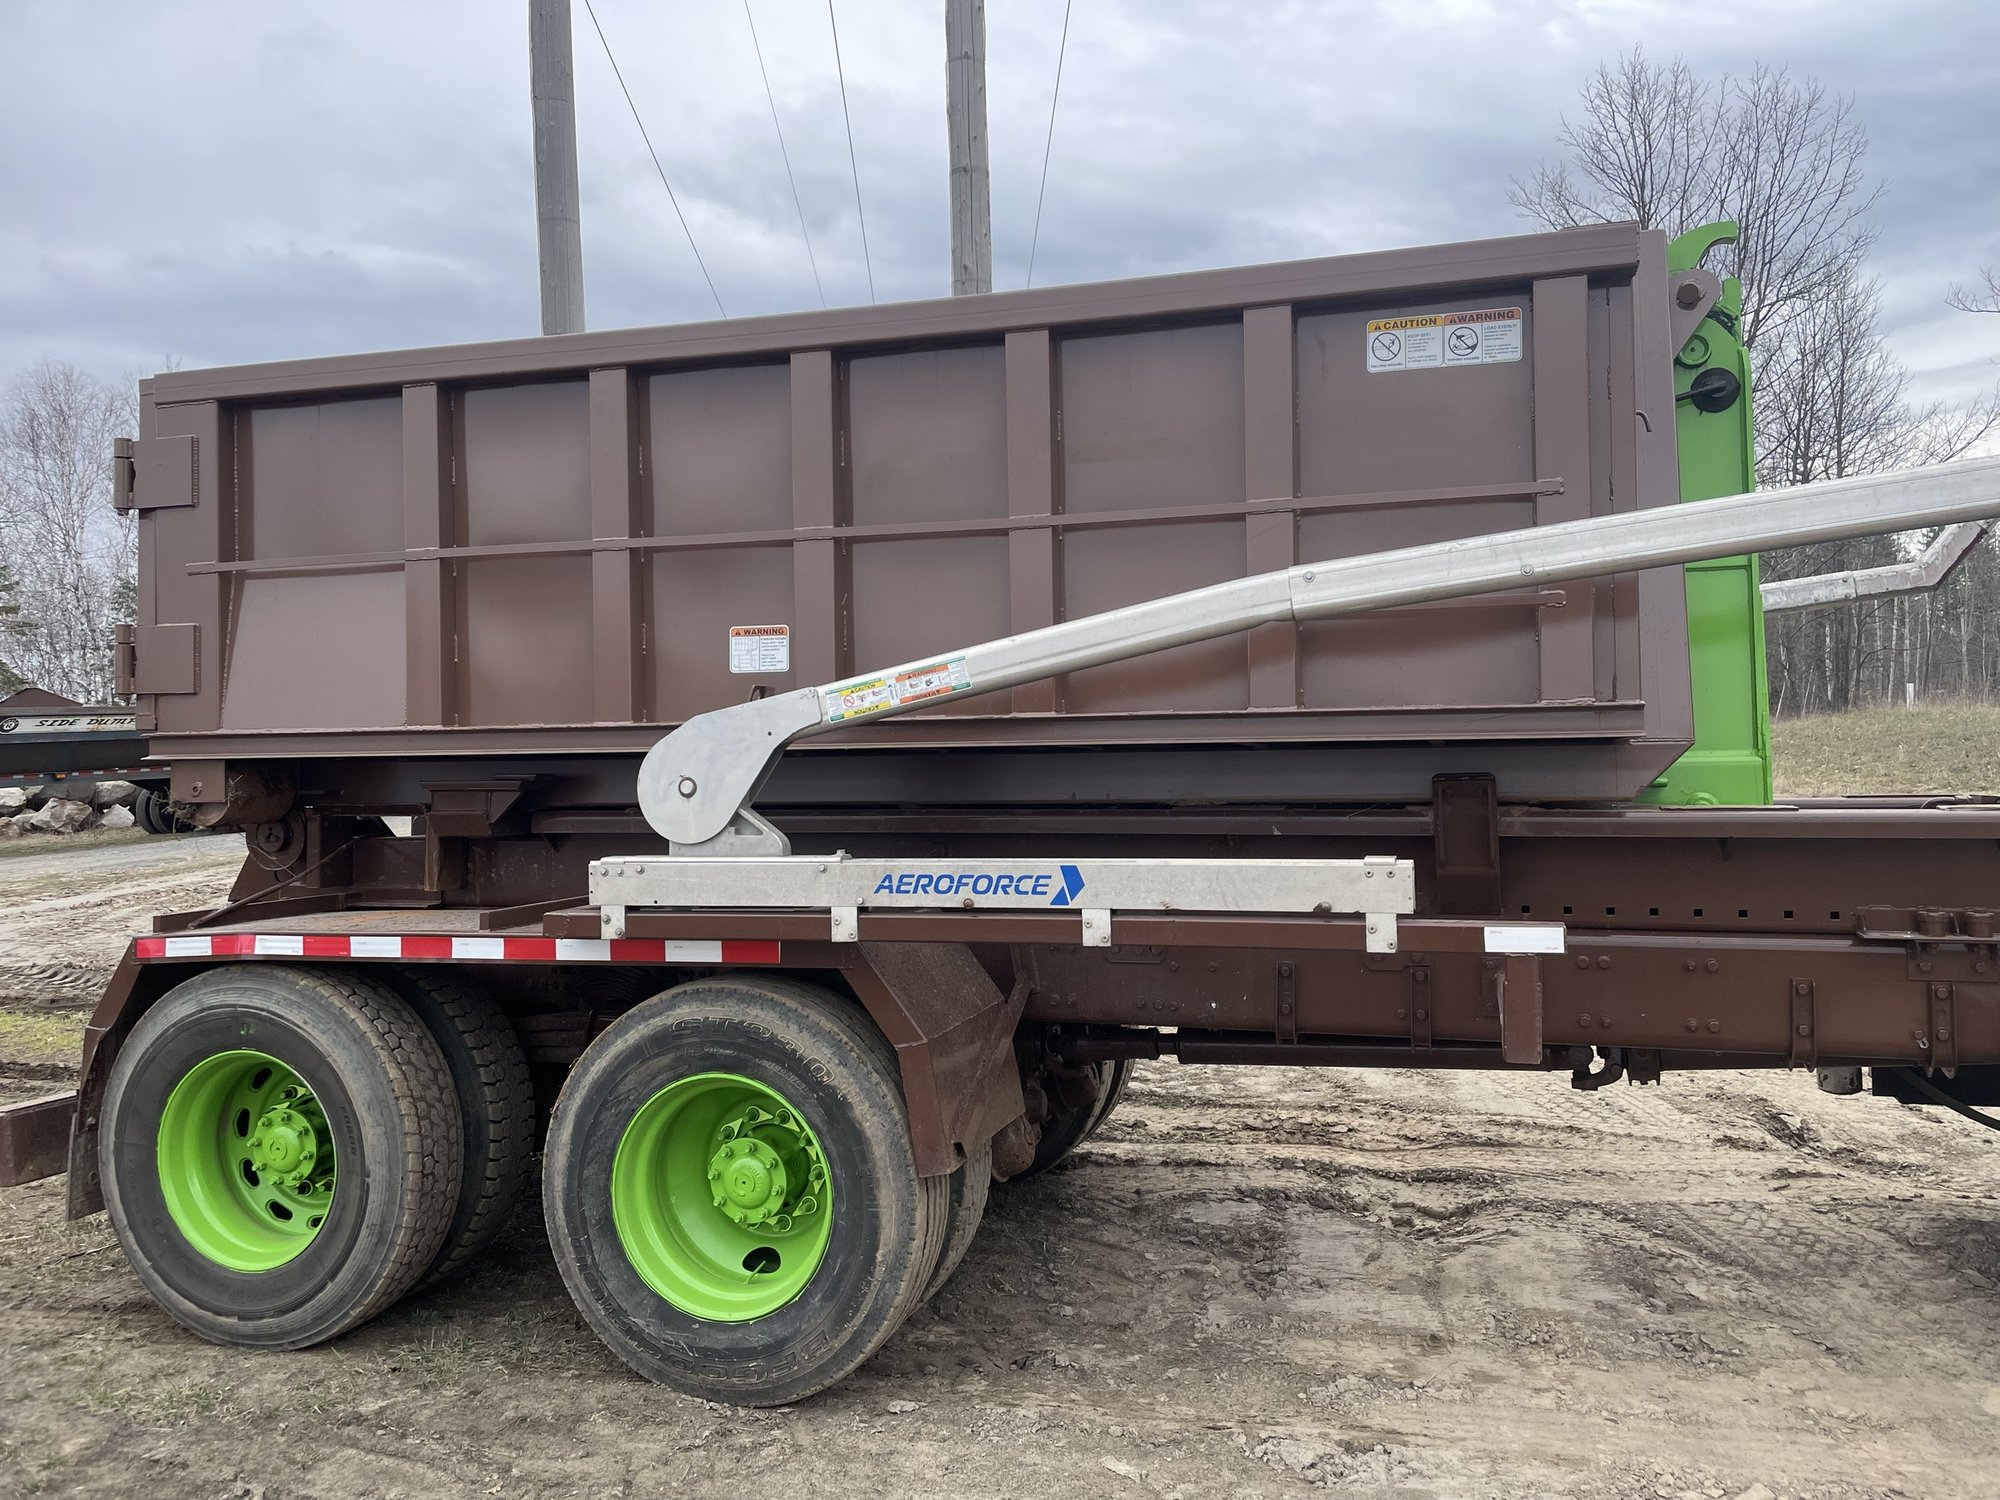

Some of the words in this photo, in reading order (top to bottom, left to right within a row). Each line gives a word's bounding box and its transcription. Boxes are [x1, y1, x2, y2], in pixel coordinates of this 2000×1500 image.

[1457, 311, 1514, 323] WARNING
[1383, 318, 1437, 330] CAUTION
[855, 684, 876, 692] CAUTION
[35, 719, 81, 727] SIDE
[873, 874, 1052, 895] AEROFORCE
